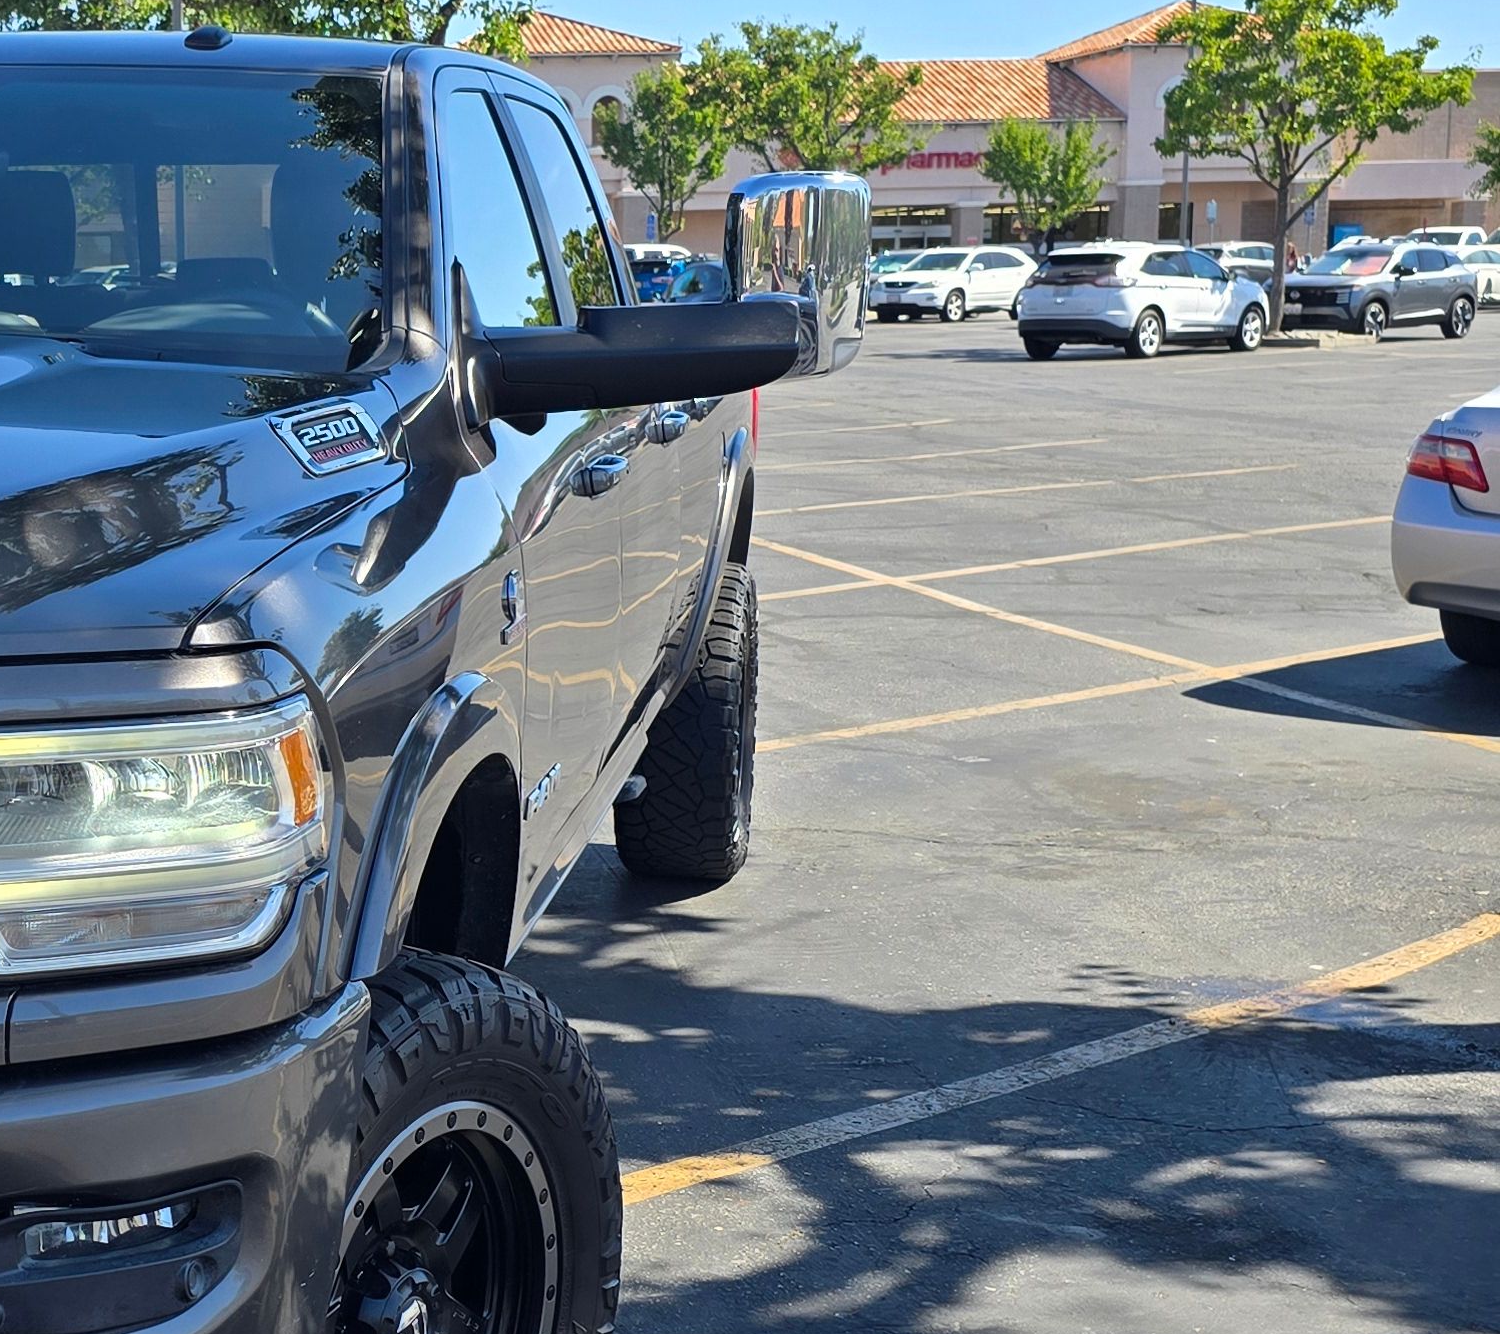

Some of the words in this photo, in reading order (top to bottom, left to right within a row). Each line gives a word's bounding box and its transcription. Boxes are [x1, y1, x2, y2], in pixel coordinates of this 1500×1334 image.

[299, 418, 360, 447] 2500
[312, 447, 345, 462] HEAVY
[343, 437, 369, 454] DUTY
